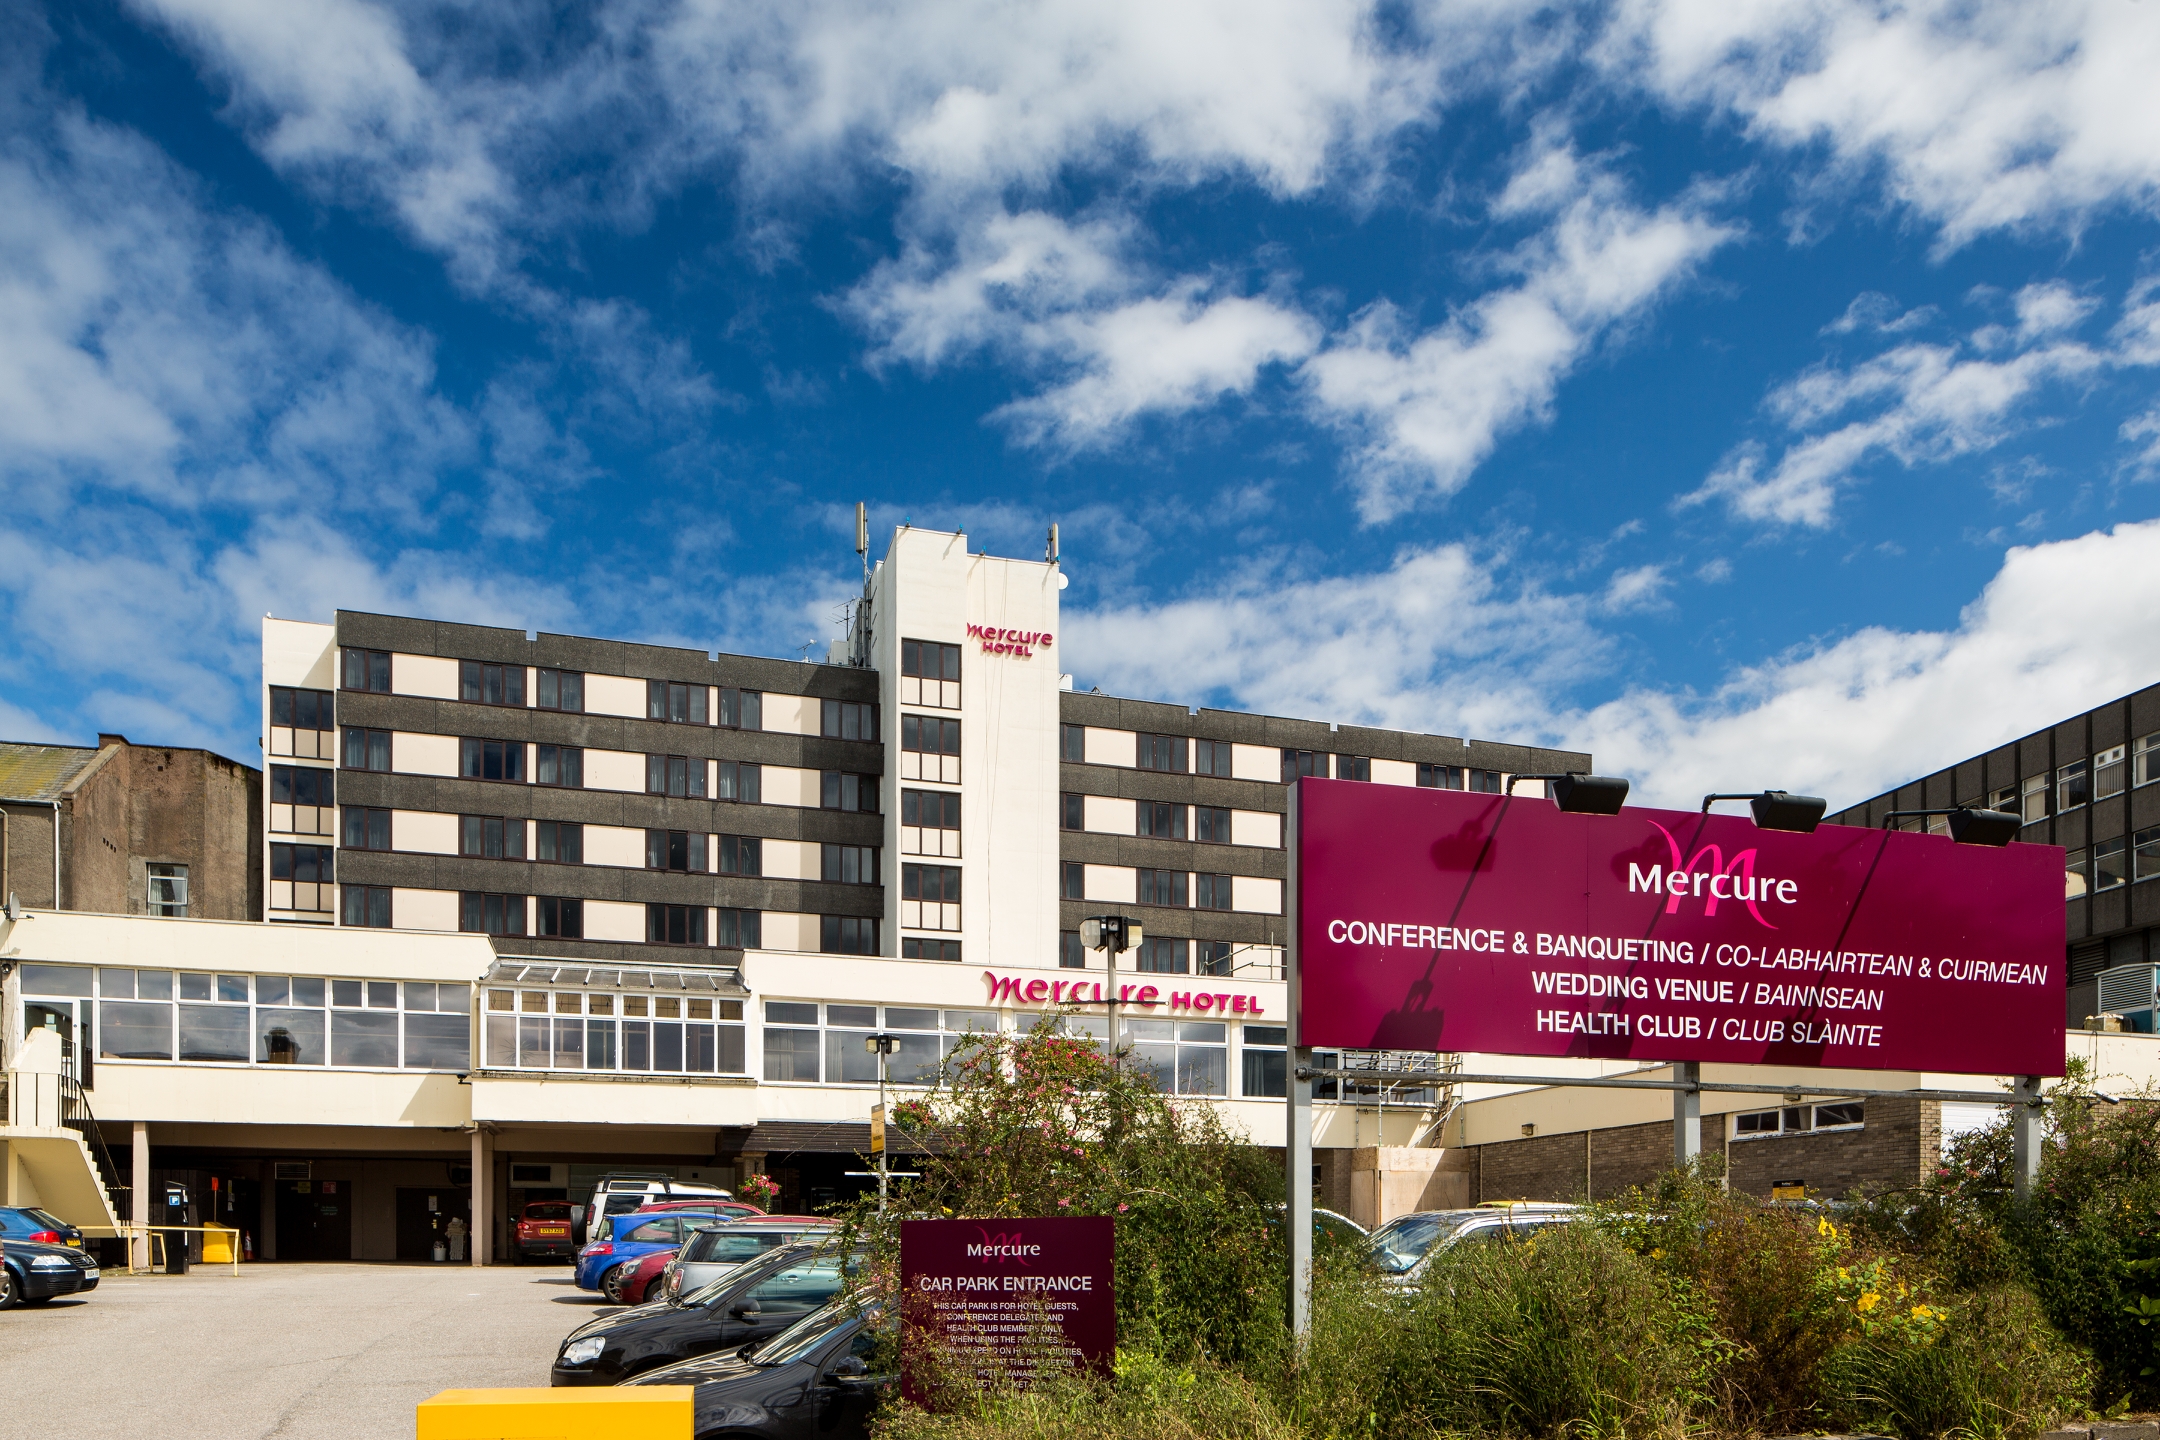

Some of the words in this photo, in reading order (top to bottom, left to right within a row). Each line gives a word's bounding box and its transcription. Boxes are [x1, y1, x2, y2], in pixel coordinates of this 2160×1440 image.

[982, 641, 1033, 657] HOTEL
[1628, 862, 1798, 904] Mercure
[1327, 919, 1505, 953] CONFERENCE
[1511, 931, 1530, 955] &
[1536, 932, 1694, 964] BANQUETING
[1699, 942, 1711, 965] /
[1716, 943, 1914, 977] CO-LABHAIRTEAN
[1918, 957, 1932, 978] &
[1938, 957, 2048, 986] CUIRMEAN
[1531, 970, 1648, 999] WEDDING
[1654, 977, 1734, 1003] VENUE
[1738, 981, 1750, 1004] /
[1754, 982, 1884, 1011] BAINNSEAN
[1172, 991, 1265, 1013] HOTEL
[1536, 1009, 1629, 1036] HEALTH
[1637, 1014, 1701, 1039] CLUB
[1706, 1017, 1718, 1040] /
[1722, 1018, 1786, 1042] CLUB
[1791, 1018, 1883, 1047] SLÀINTE
[966, 1243, 1041, 1257] Mercure
[920, 1276, 953, 1291] CAR
[956, 1276, 999, 1291] PARK
[1003, 1276, 1092, 1291] ENTRANCE
[951, 1302, 967, 1311] CAR
[968, 1302, 989, 1311] PARK
[990, 1302, 999, 1311] IS
[1000, 1302, 1016, 1311] FOR
[1047, 1313, 1064, 1322] AND
[978, 1324, 999, 1333] CLUB
[950, 1335, 973, 1344] WHEN
[1000, 1335, 1016, 1344] THE
